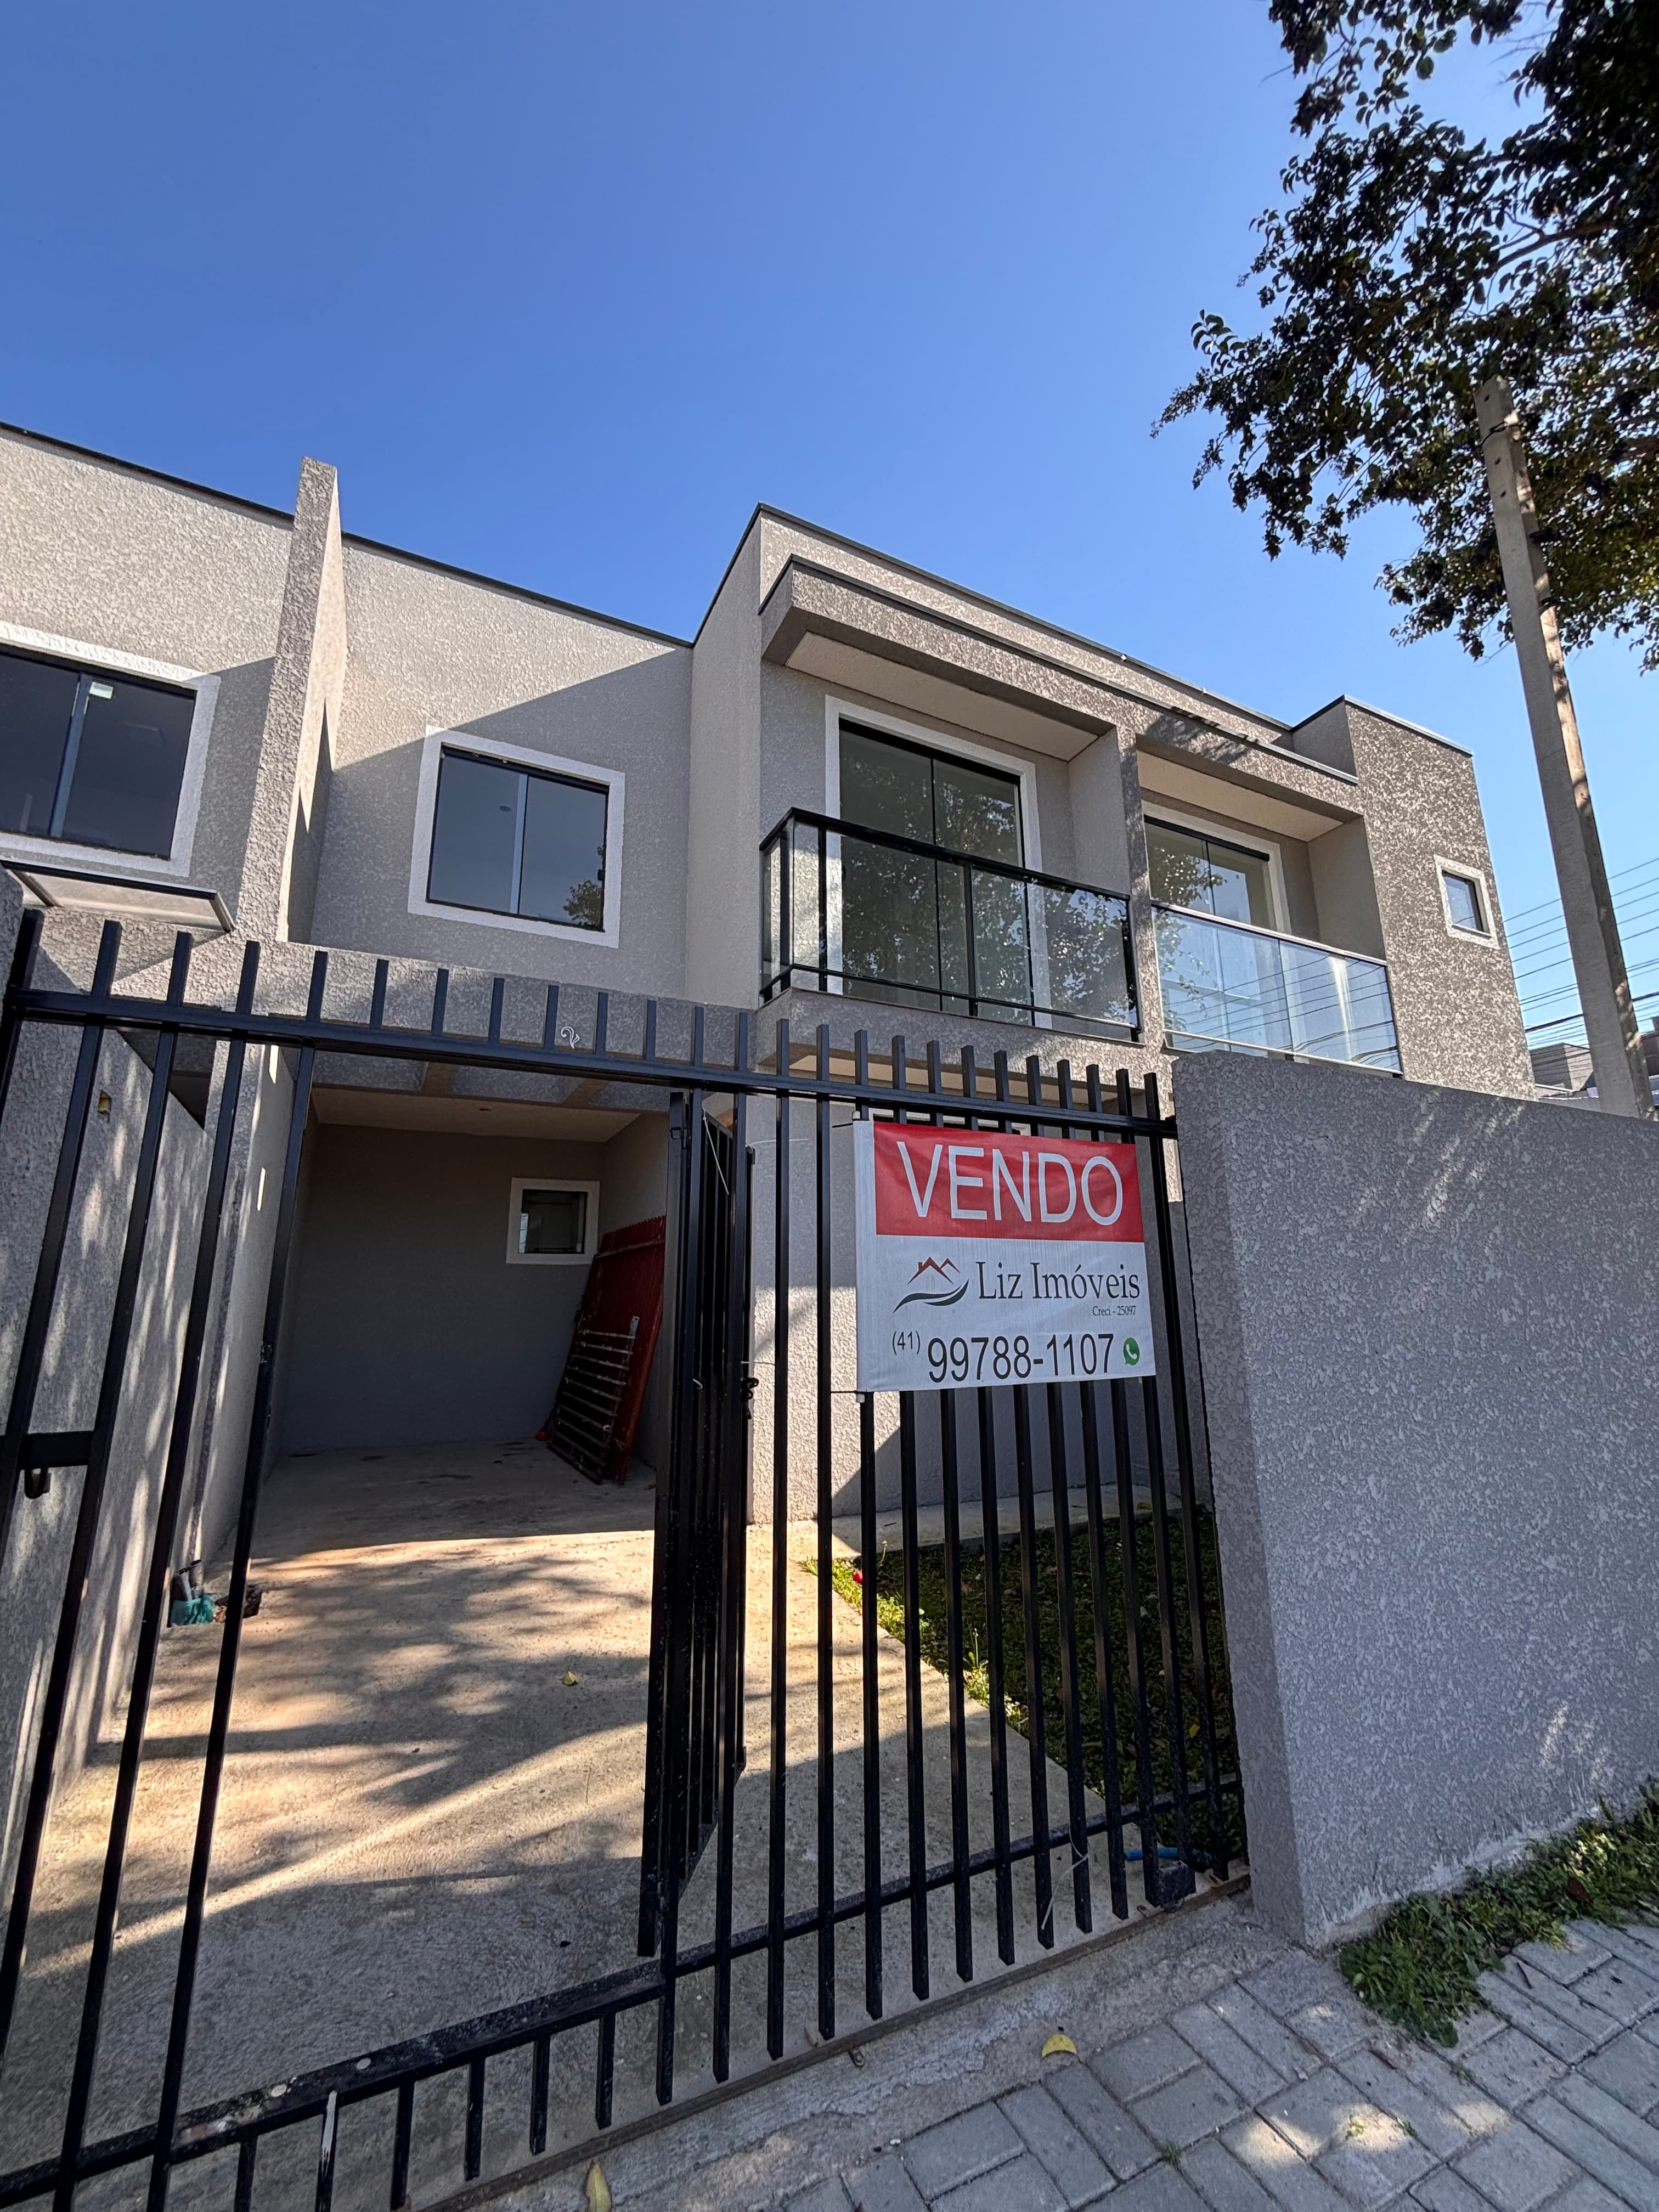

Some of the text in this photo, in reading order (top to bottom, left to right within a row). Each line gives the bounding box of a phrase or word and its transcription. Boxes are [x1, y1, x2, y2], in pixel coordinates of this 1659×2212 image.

[896, 1141, 1123, 1226] VENDO
[975, 1261, 1140, 1300] Liz Imóveis
[1092, 1305, 1111, 1316] Creci
[1117, 1305, 1136, 1316] 25097
[892, 1330, 1114, 1383] (41) 99788-1107
